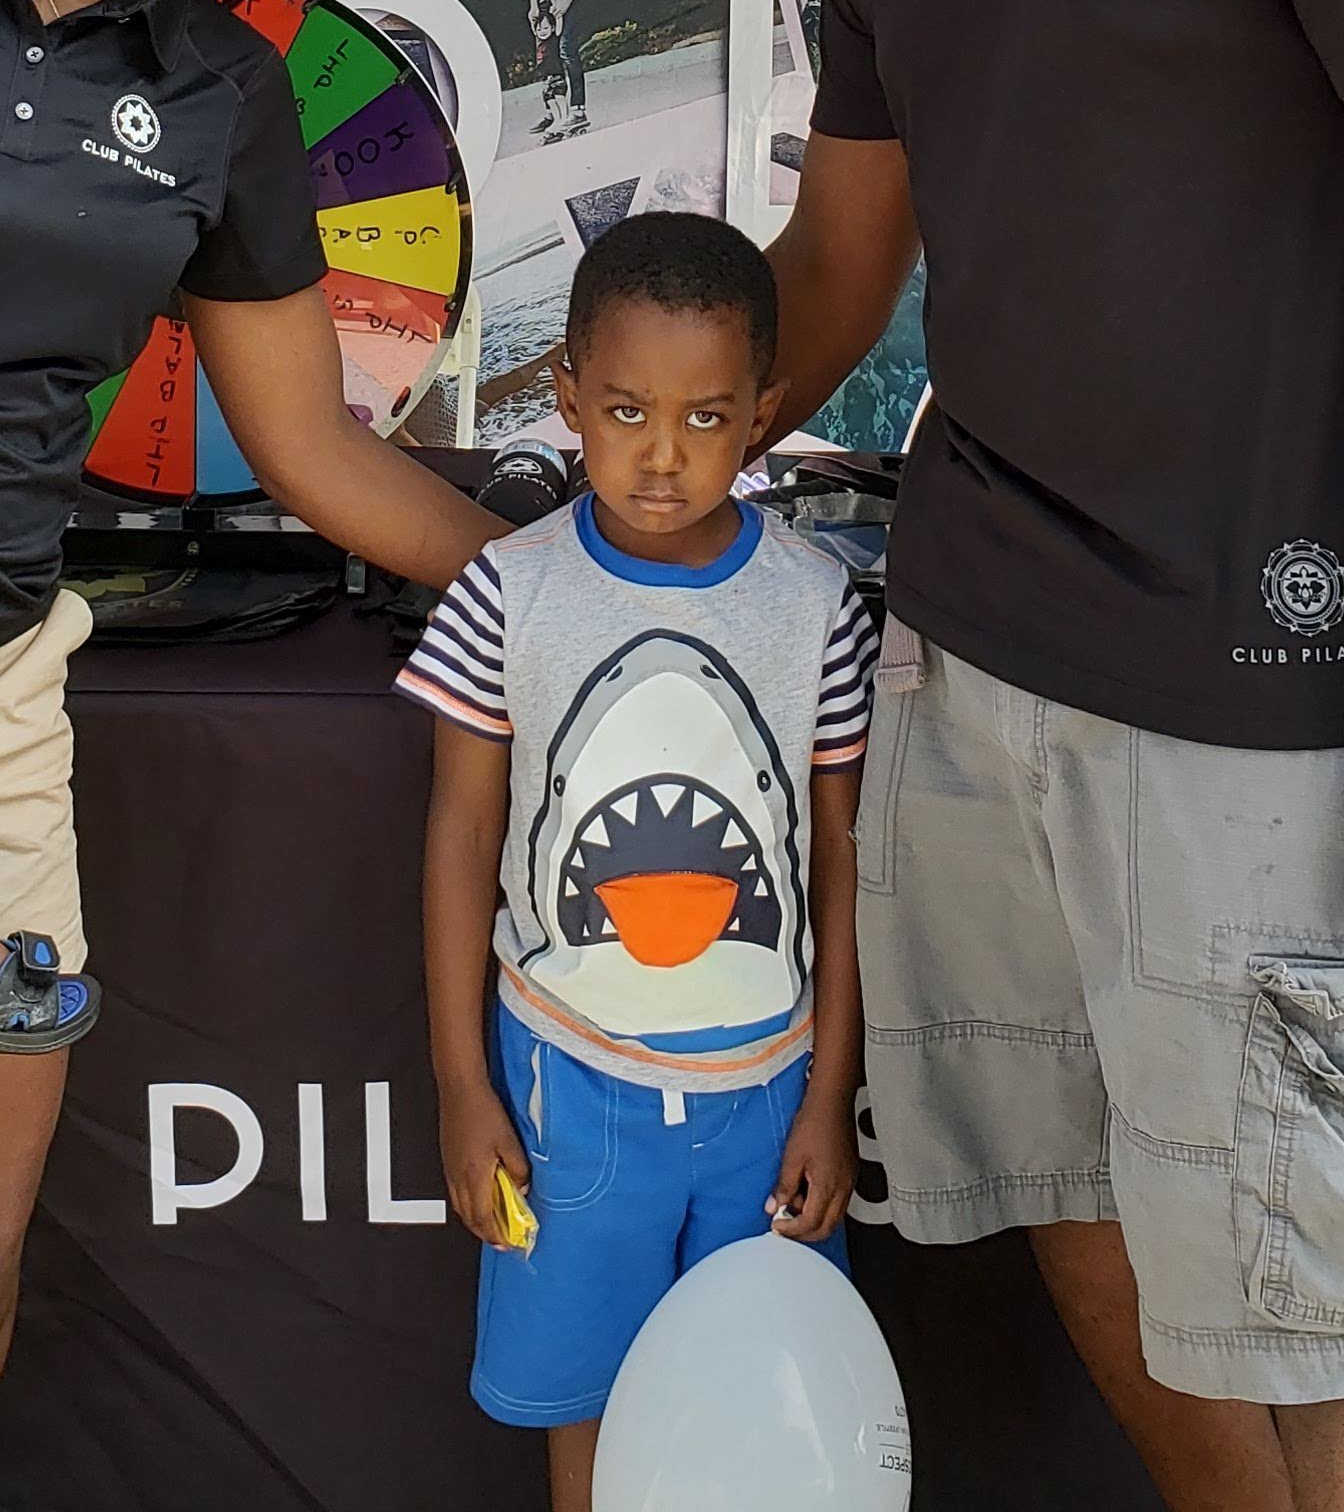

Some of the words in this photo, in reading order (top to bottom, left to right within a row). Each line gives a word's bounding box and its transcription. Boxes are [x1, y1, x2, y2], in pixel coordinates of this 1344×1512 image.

[81, 138, 120, 162] CLUB
[123, 154, 176, 187] PILATES
[1231, 647, 1288, 664] CLUB
